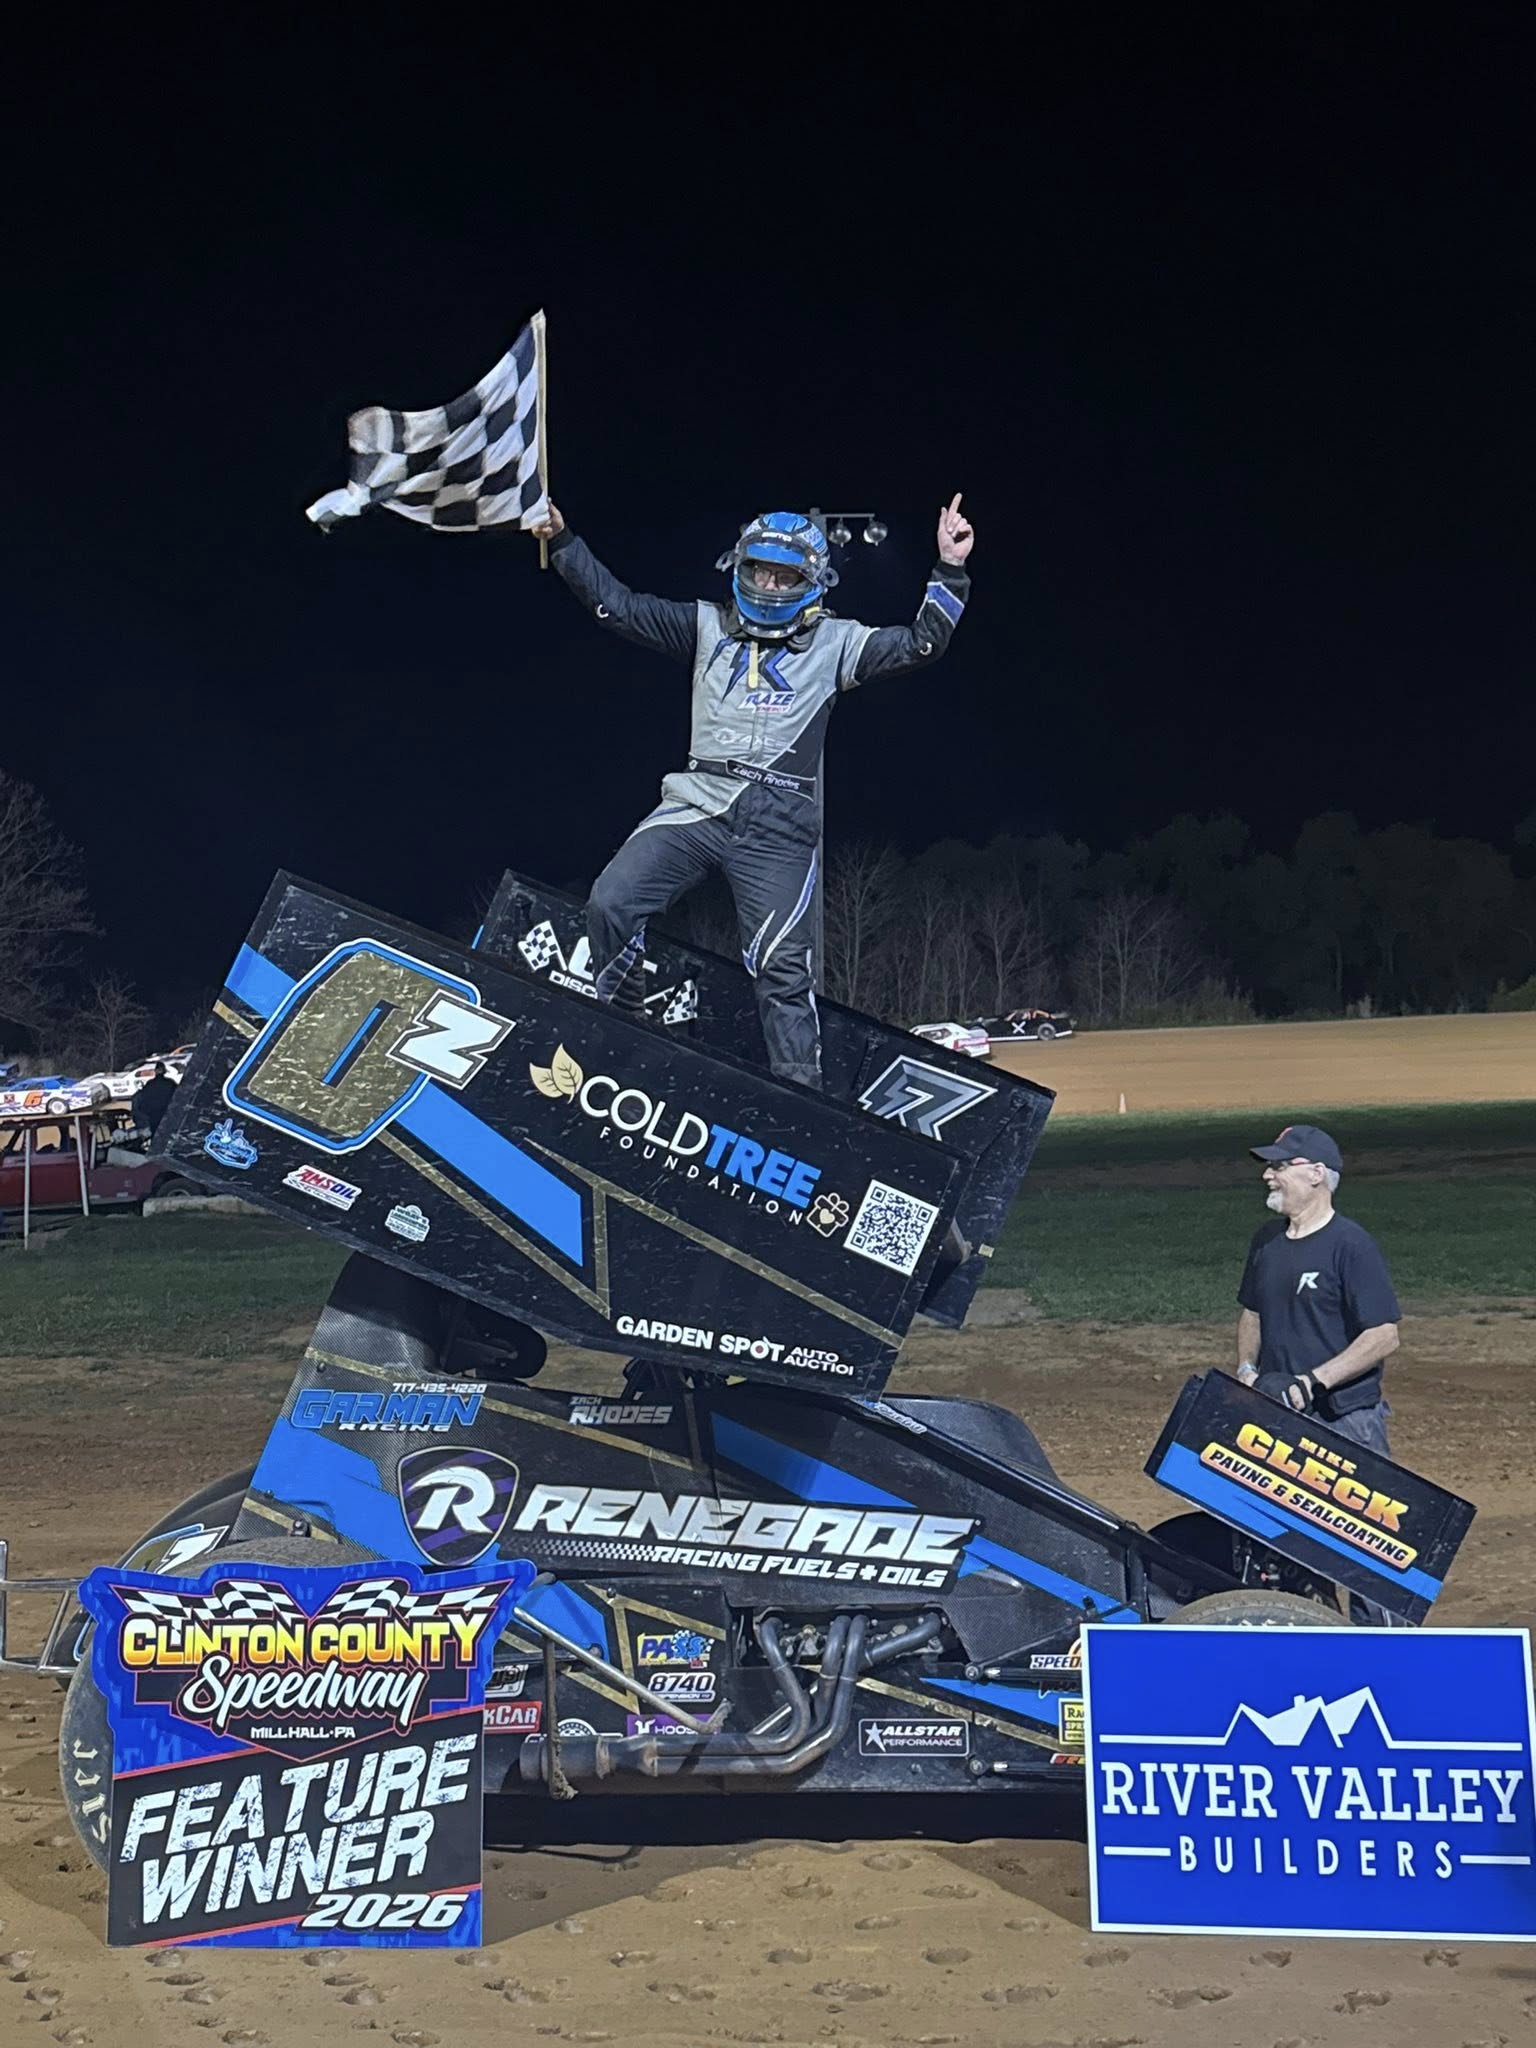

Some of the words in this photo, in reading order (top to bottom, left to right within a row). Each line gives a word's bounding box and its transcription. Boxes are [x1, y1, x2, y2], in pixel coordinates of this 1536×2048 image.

[733, 764, 762, 781] Zach
[763, 773, 800, 790] Rhodes
[296, 1168, 357, 1199] AMSOIL
[600, 1126, 803, 1226] FOUNDATION
[616, 1316, 714, 1349] GARDEN
[719, 1334, 785, 1362] SPOT
[791, 1346, 839, 1363] AUTO
[392, 1383, 487, 1394] 717-435-4220
[291, 1389, 485, 1429] GARMAN
[338, 1423, 451, 1432] RACING
[569, 1405, 673, 1425] RHODES
[1298, 1437, 1357, 1475] MIKE
[1236, 1423, 1409, 1532] CLECK
[513, 1483, 976, 1565] RENEGADE
[1209, 1449, 1273, 1489] PAVING
[1273, 1484, 1288, 1497] &
[1289, 1493, 1409, 1562] SEALCOATING
[651, 1546, 763, 1572] RACING
[123, 1615, 299, 1665] CLINTON
[310, 1613, 489, 1664] COUNTY
[640, 1636, 706, 1658] PASS
[1032, 1655, 1082, 1668] SPEED
[183, 1654, 423, 1728] Speedway
[650, 1675, 714, 1692] 8740
[882, 1725, 963, 1736] ALLSTAR
[883, 1738, 963, 1747] PERFORMANCE
[119, 1733, 478, 1864] FEATURE
[1100, 1761, 1278, 1819] RIVER
[1291, 1765, 1524, 1824] VALLEY
[142, 1811, 435, 1924] WINNER
[1179, 1835, 1453, 1880] BUILDERS
[302, 1893, 470, 1929] 2026
